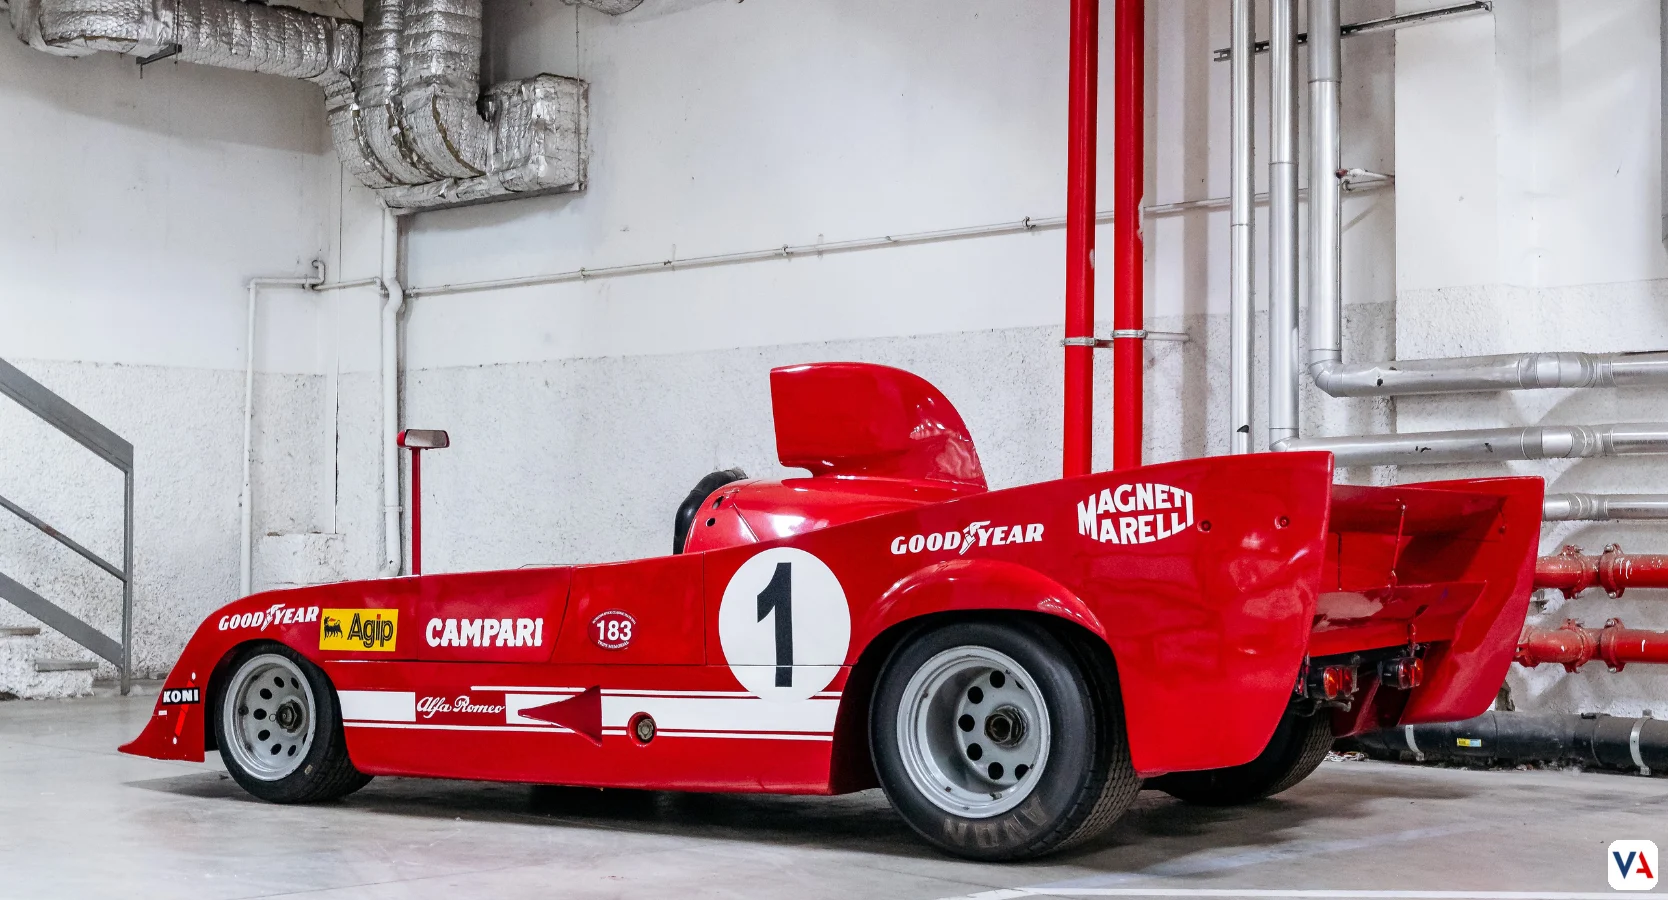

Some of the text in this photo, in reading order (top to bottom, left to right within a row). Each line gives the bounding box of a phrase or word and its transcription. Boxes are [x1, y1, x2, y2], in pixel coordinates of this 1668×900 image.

[1077, 483, 1194, 528] MAGNETI
[1077, 500, 1194, 544] MARELLI
[890, 520, 1045, 555] GOODYEAR
[218, 604, 319, 631] GOODYEAR
[347, 612, 394, 648] Agip
[425, 618, 544, 647] CAMPARI
[597, 620, 632, 641] 183
[757, 562, 793, 687] 1
[162, 689, 199, 703] KONI
[416, 695, 505, 719] Alfa Romeo
[943, 794, 1048, 849] AVON
